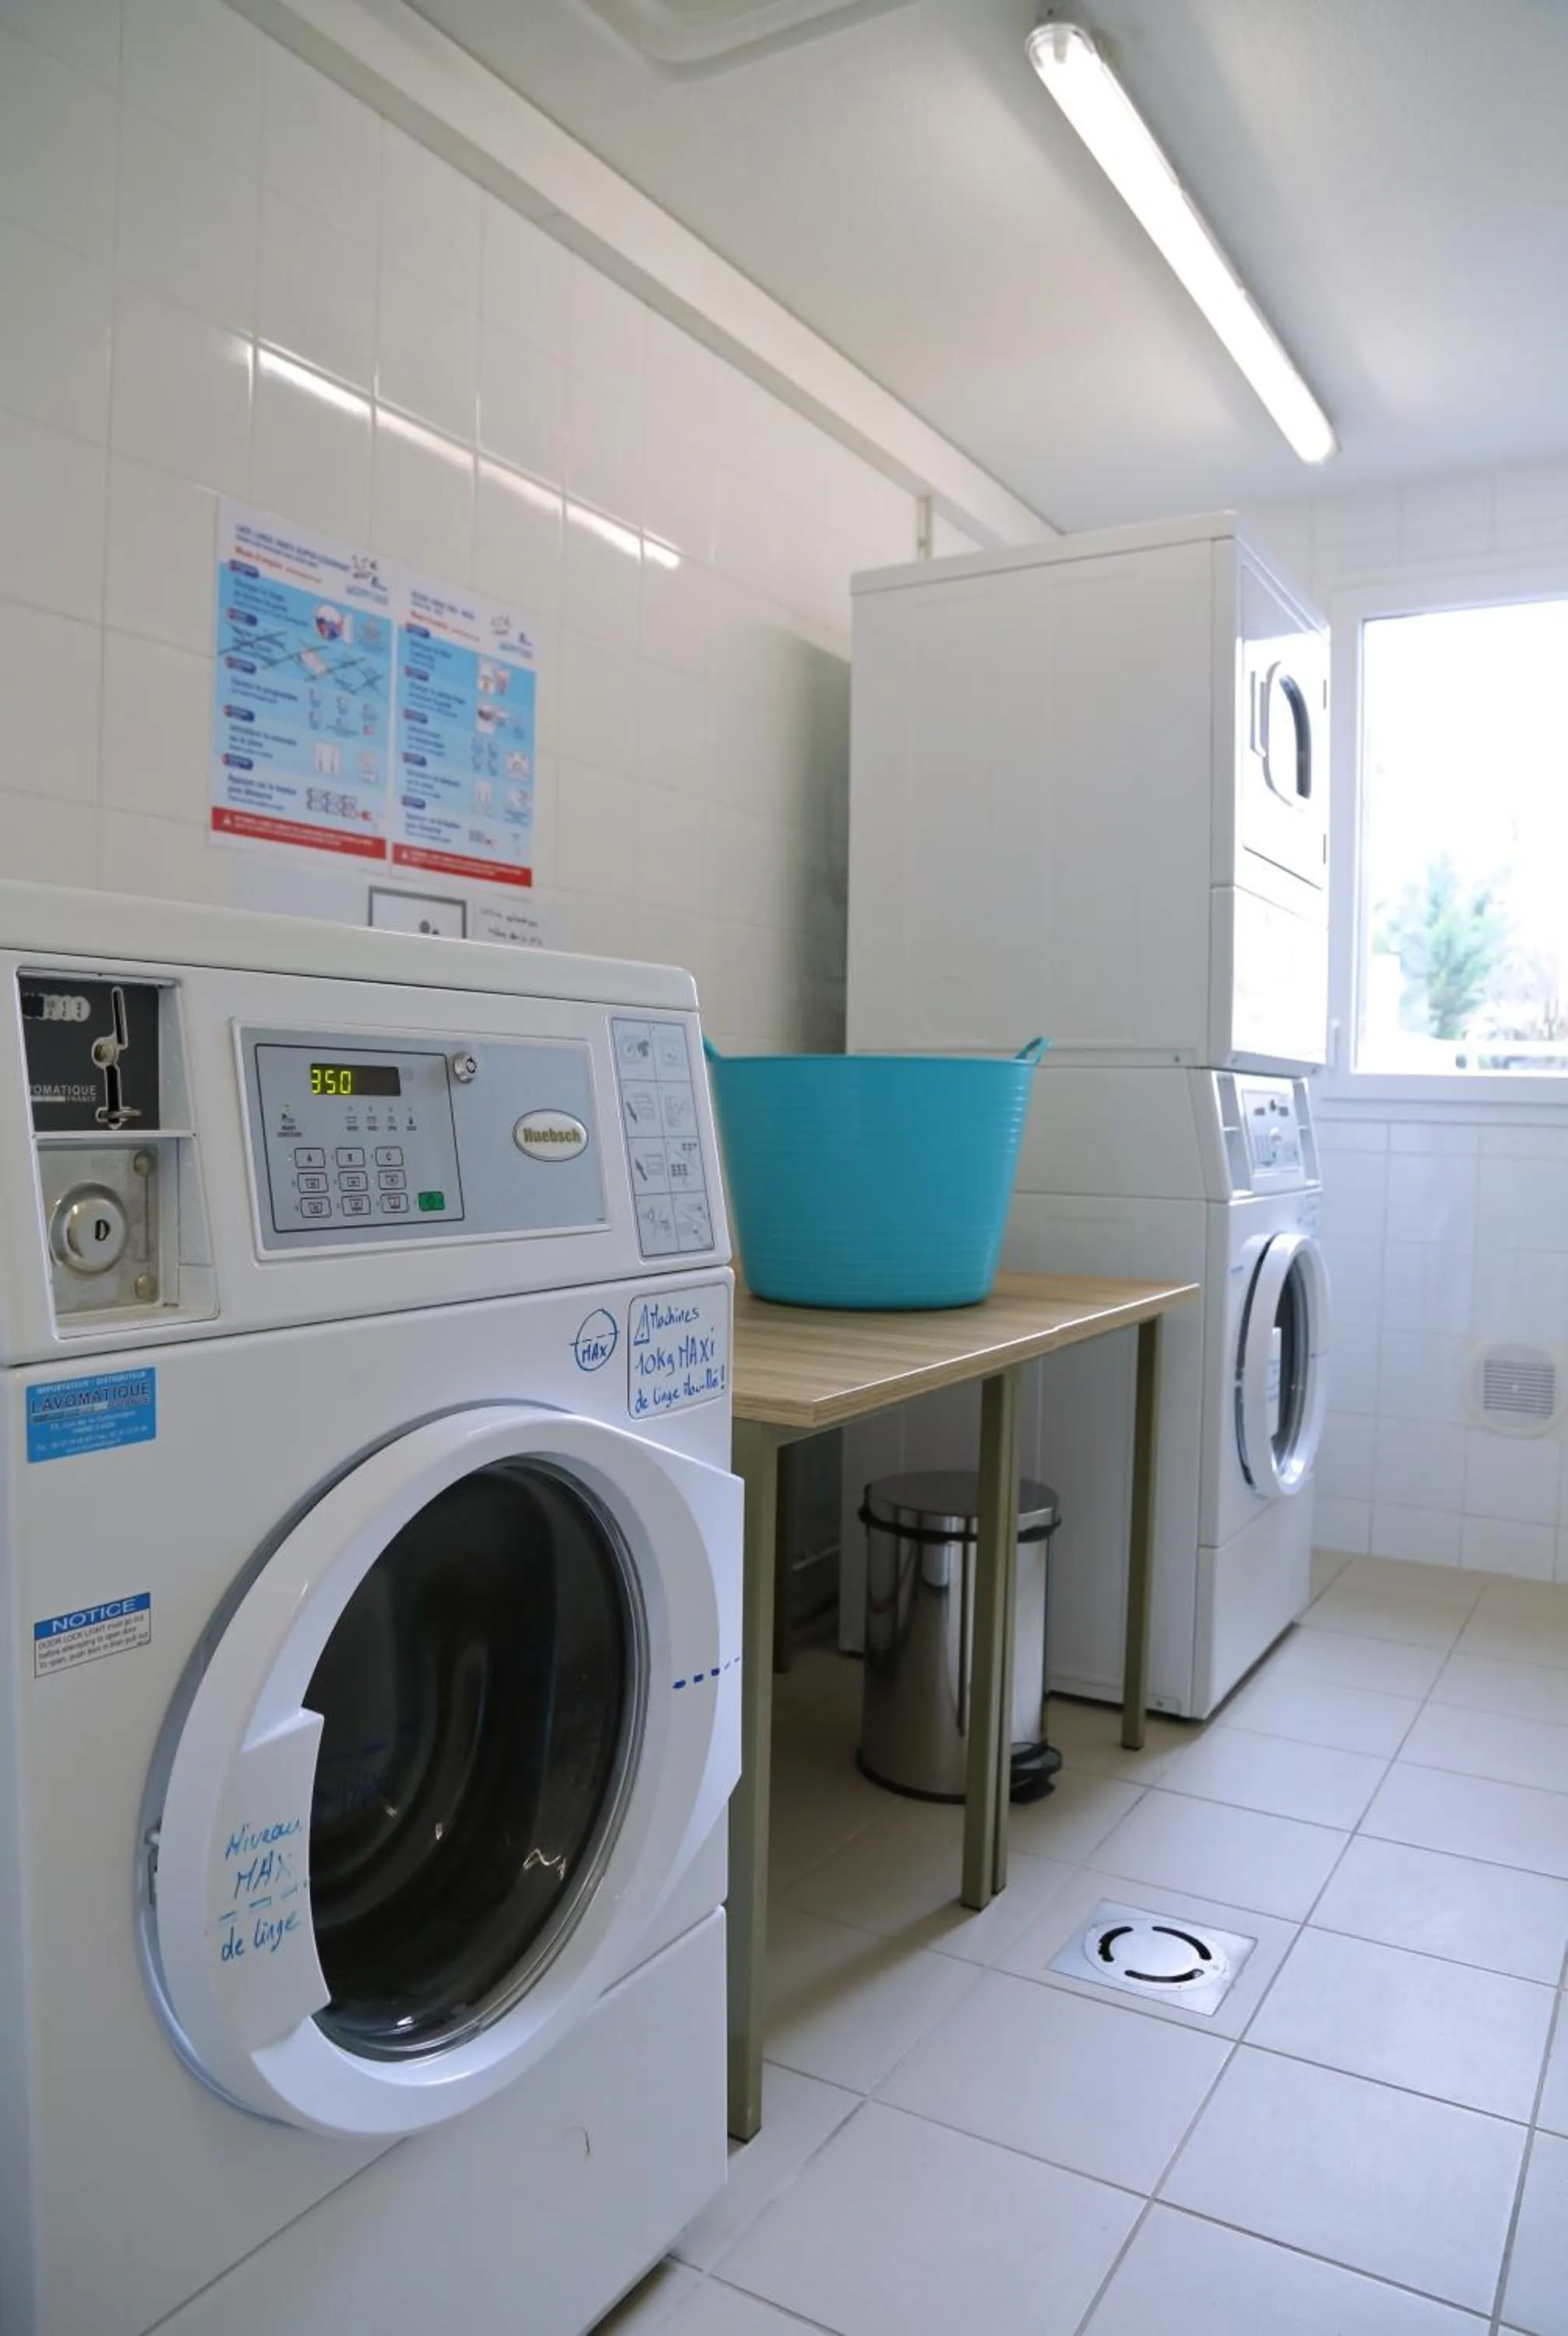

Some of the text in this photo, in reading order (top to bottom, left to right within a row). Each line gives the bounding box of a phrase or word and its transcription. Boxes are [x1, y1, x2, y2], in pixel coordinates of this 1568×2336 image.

[30, 1084, 97, 1096] OMATIQUE
[311, 1069, 351, 1094] 350
[523, 1128, 581, 1143] Huebsch
[582, 1342, 608, 1362] MAX
[31, 1382, 150, 1413] LAVOMATIQUE
[635, 1389, 649, 1413] de
[52, 1599, 136, 1632] NOTICE
[63, 1632, 82, 1644] LOCK
[234, 1849, 292, 1900] MAX
[222, 1911, 301, 1962] de linge
